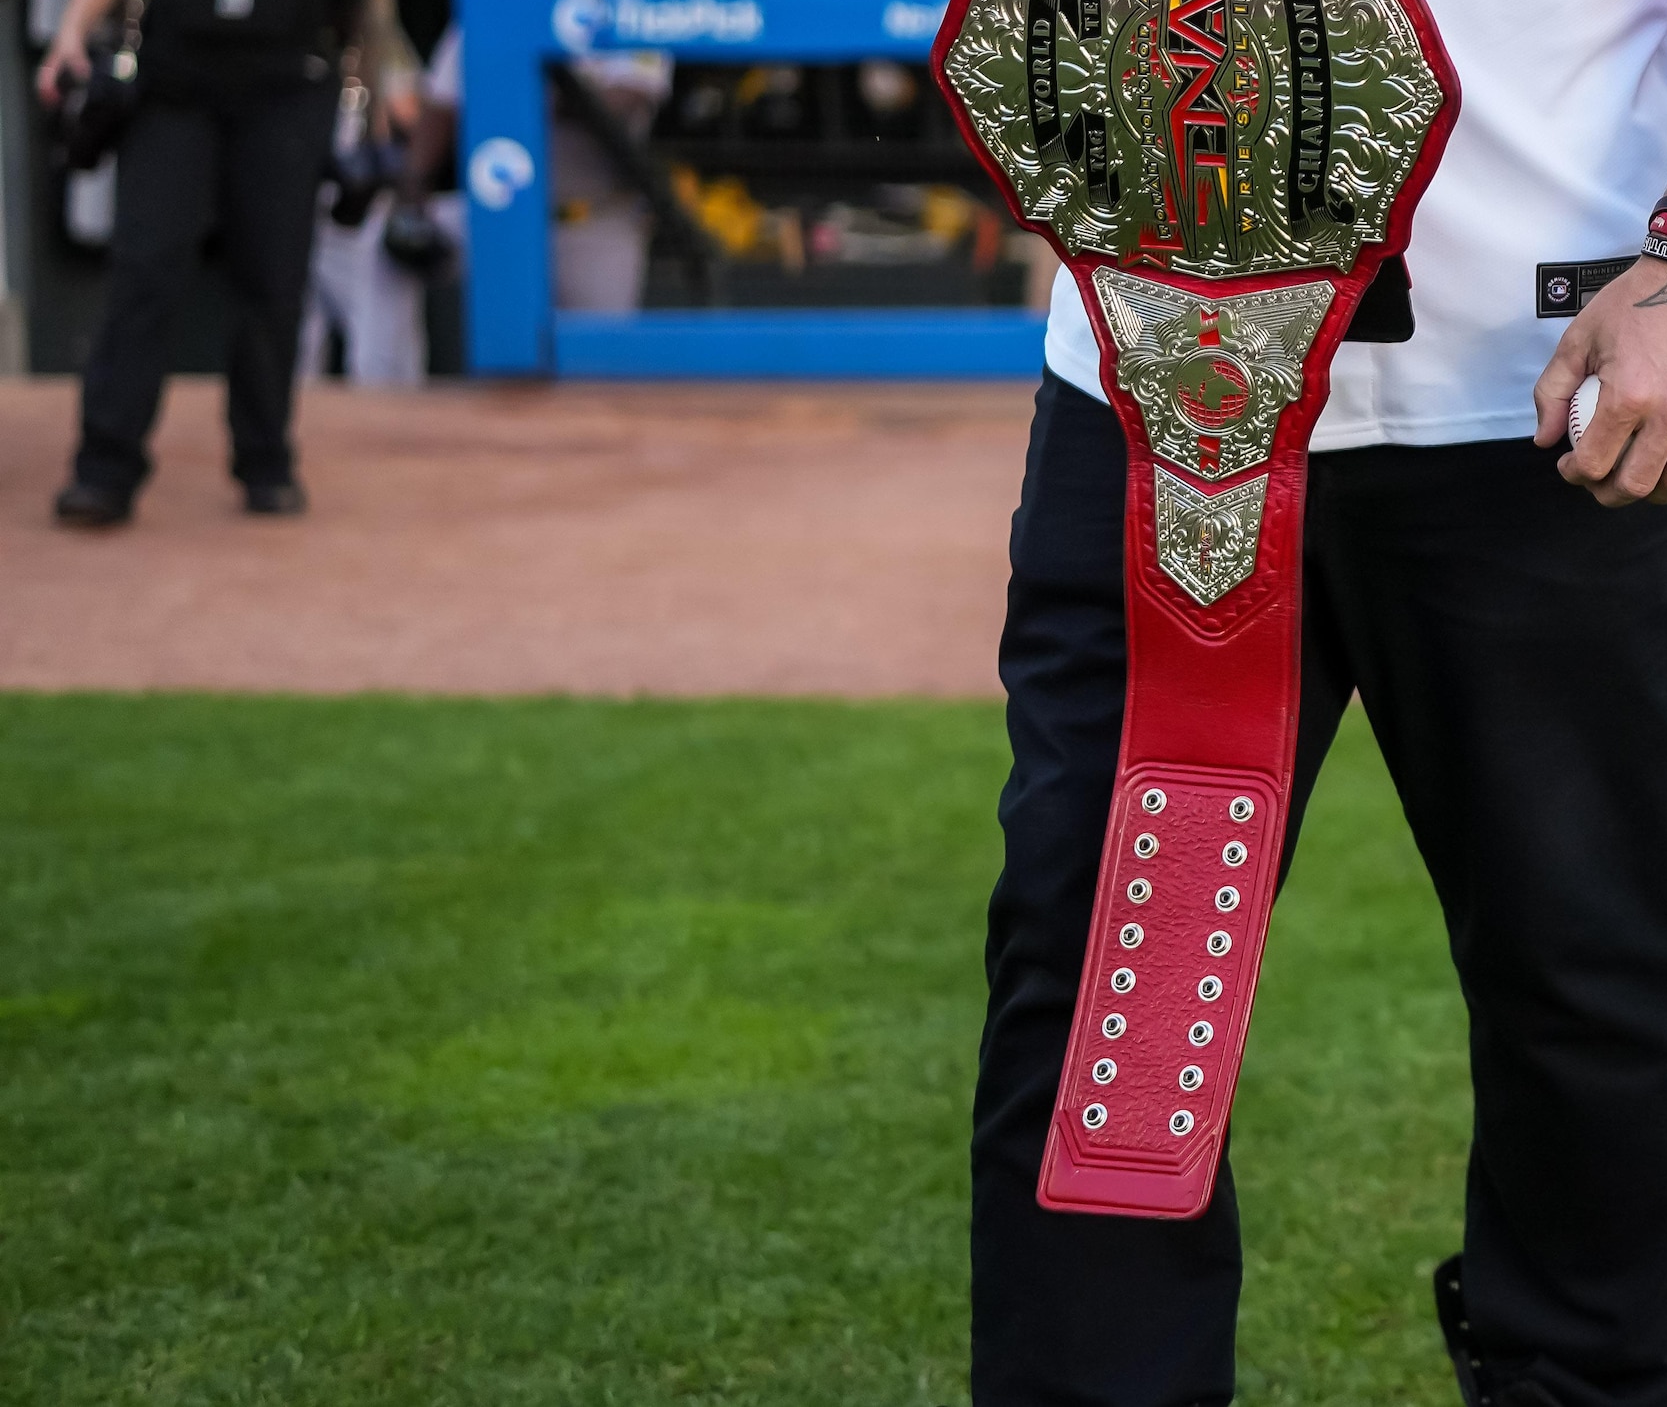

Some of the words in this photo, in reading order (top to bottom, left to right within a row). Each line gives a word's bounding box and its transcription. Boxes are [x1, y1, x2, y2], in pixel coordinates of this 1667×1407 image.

[1032, 19, 1055, 124] WORLD
[1136, 22, 1156, 147] NONSTOP
[1087, 129, 1105, 173] TAG
[1141, 161, 1171, 240] TOTAL
[1547, 276, 1571, 287] GENUINE
